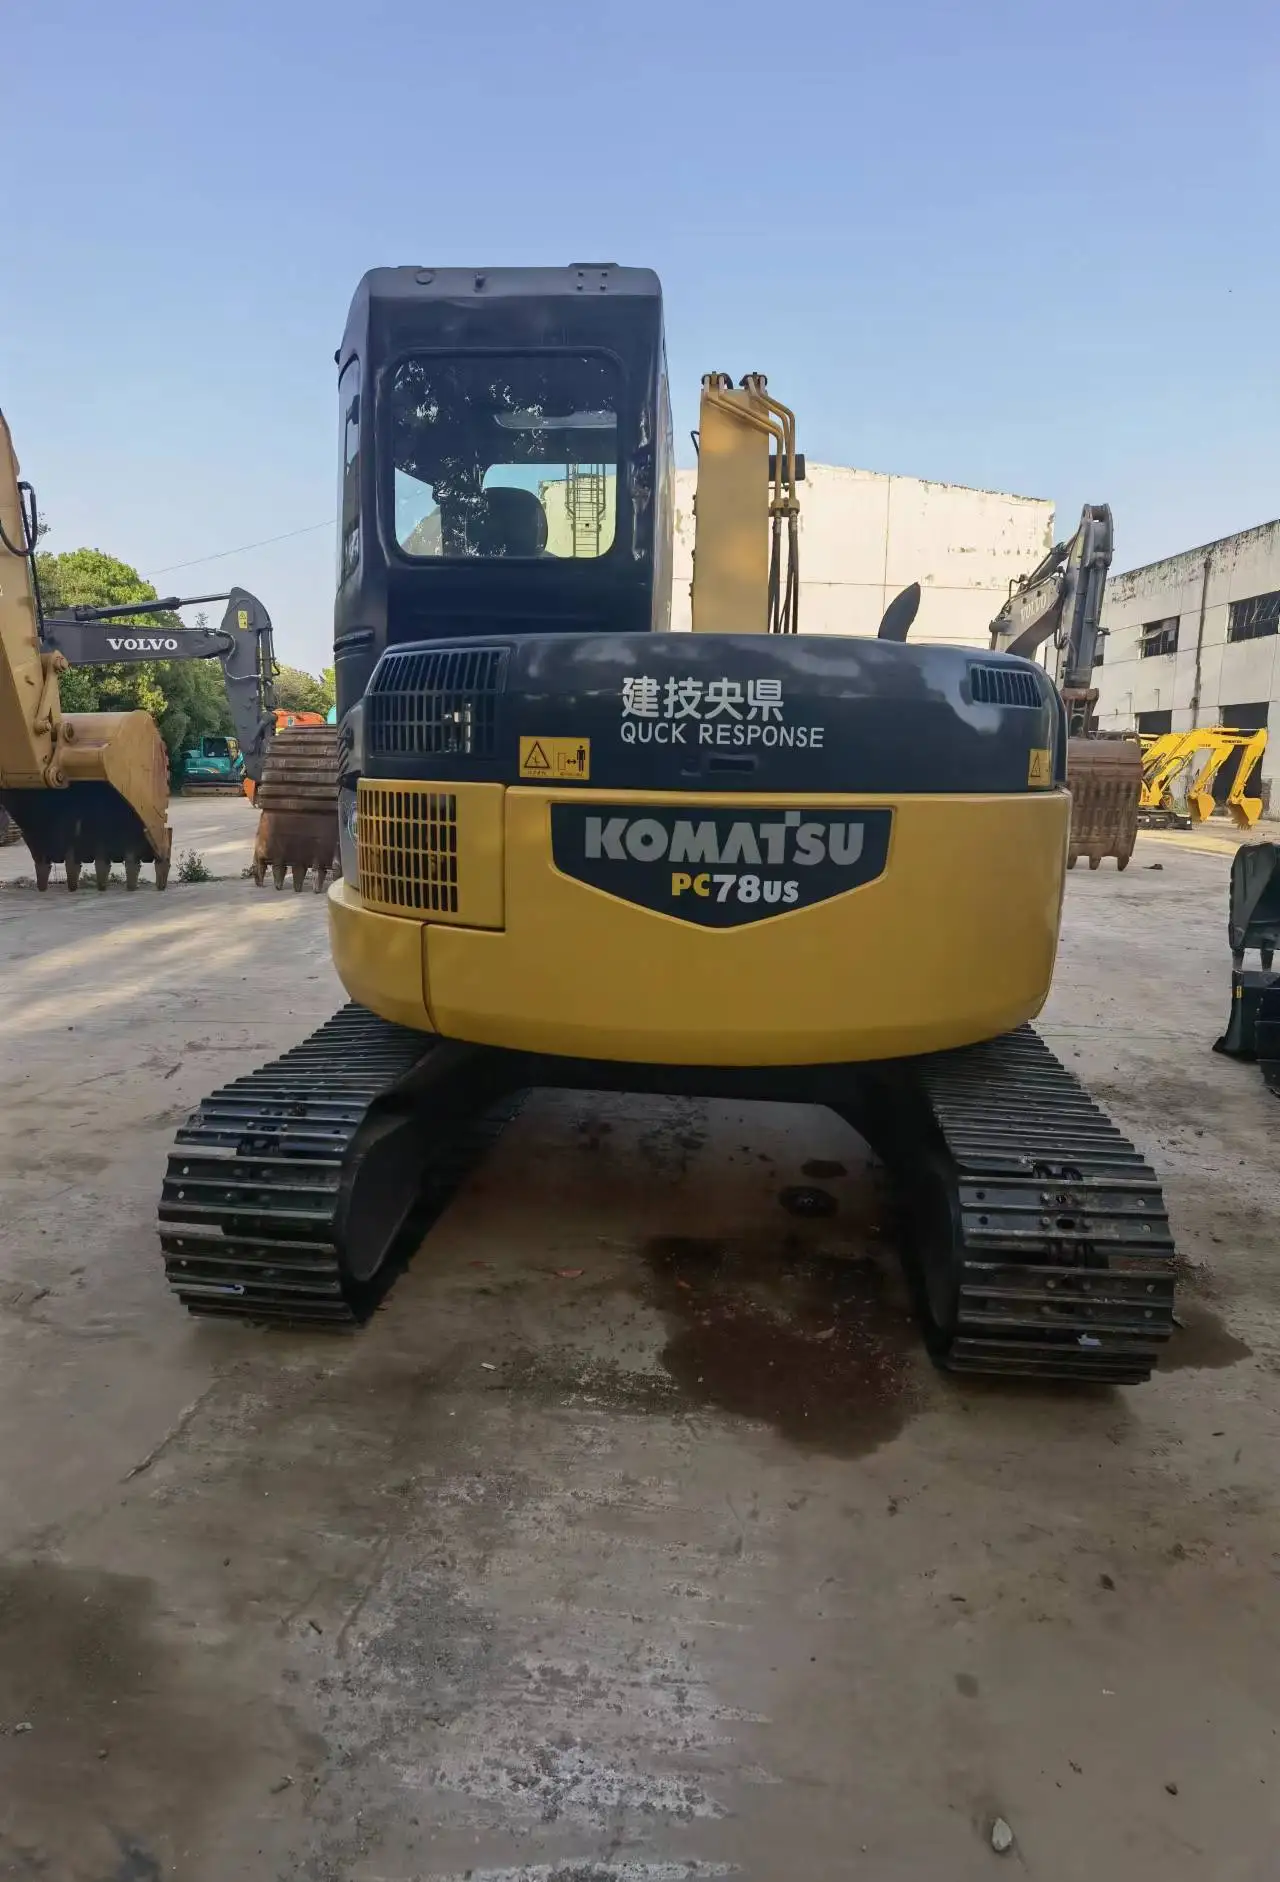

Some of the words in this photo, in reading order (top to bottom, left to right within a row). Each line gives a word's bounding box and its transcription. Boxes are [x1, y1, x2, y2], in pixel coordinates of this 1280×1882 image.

[106, 638, 178, 650] VOLVO
[621, 675, 784, 722] 建技央県
[620, 721, 687, 744] QUCK
[698, 723, 825, 748] RESPONSE
[585, 811, 864, 866] KOMATSU
